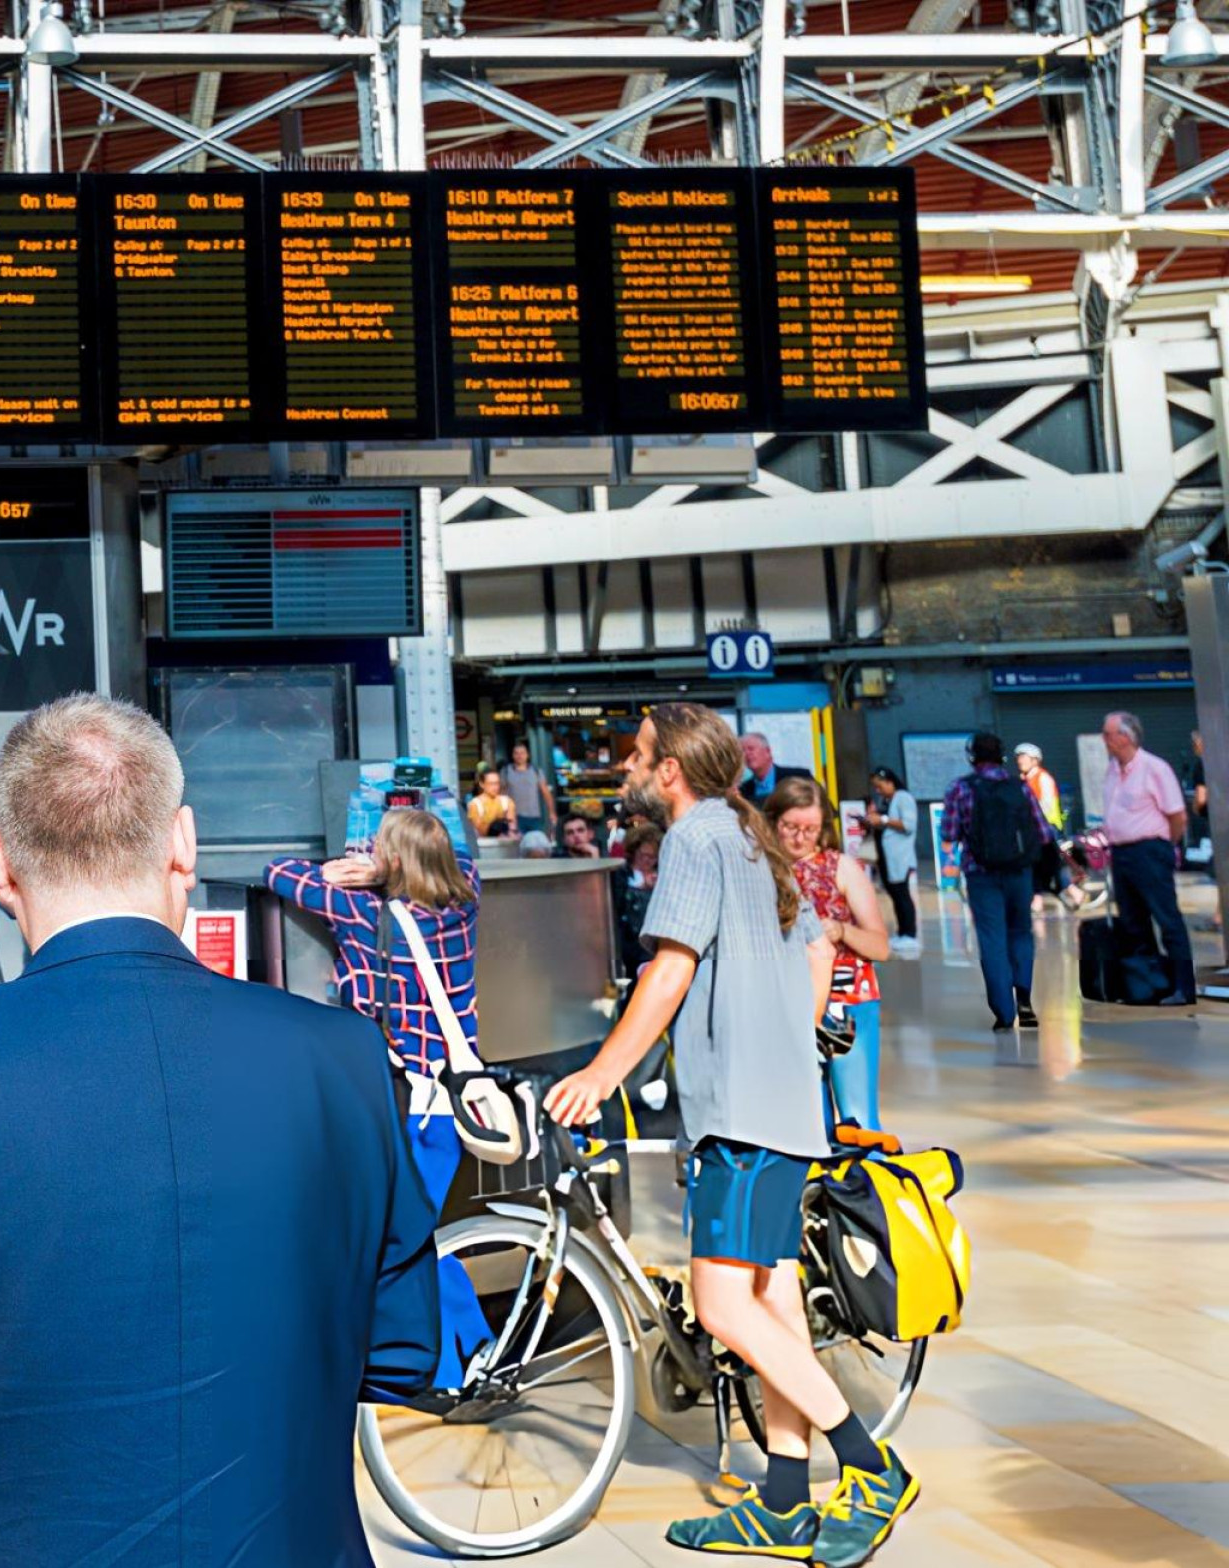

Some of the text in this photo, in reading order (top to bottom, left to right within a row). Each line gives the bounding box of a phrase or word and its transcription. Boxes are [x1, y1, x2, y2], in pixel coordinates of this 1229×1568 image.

[19, 193, 41, 209] On
[45, 193, 77, 209] time
[115, 193, 245, 210] 16:30 On time
[283, 191, 410, 208] 16:33 On time
[448, 189, 574, 206] 16:10 Platform 7
[617, 191, 727, 208] Special Notices
[771, 187, 831, 203] Arrivals
[114, 214, 177, 231] Taunton
[280, 212, 395, 228] Heathrow Term 4
[446, 210, 575, 227] Heathrow Airport
[451, 284, 578, 302] 16:25 Platform 6
[450, 306, 579, 323] Heathrow Airport
